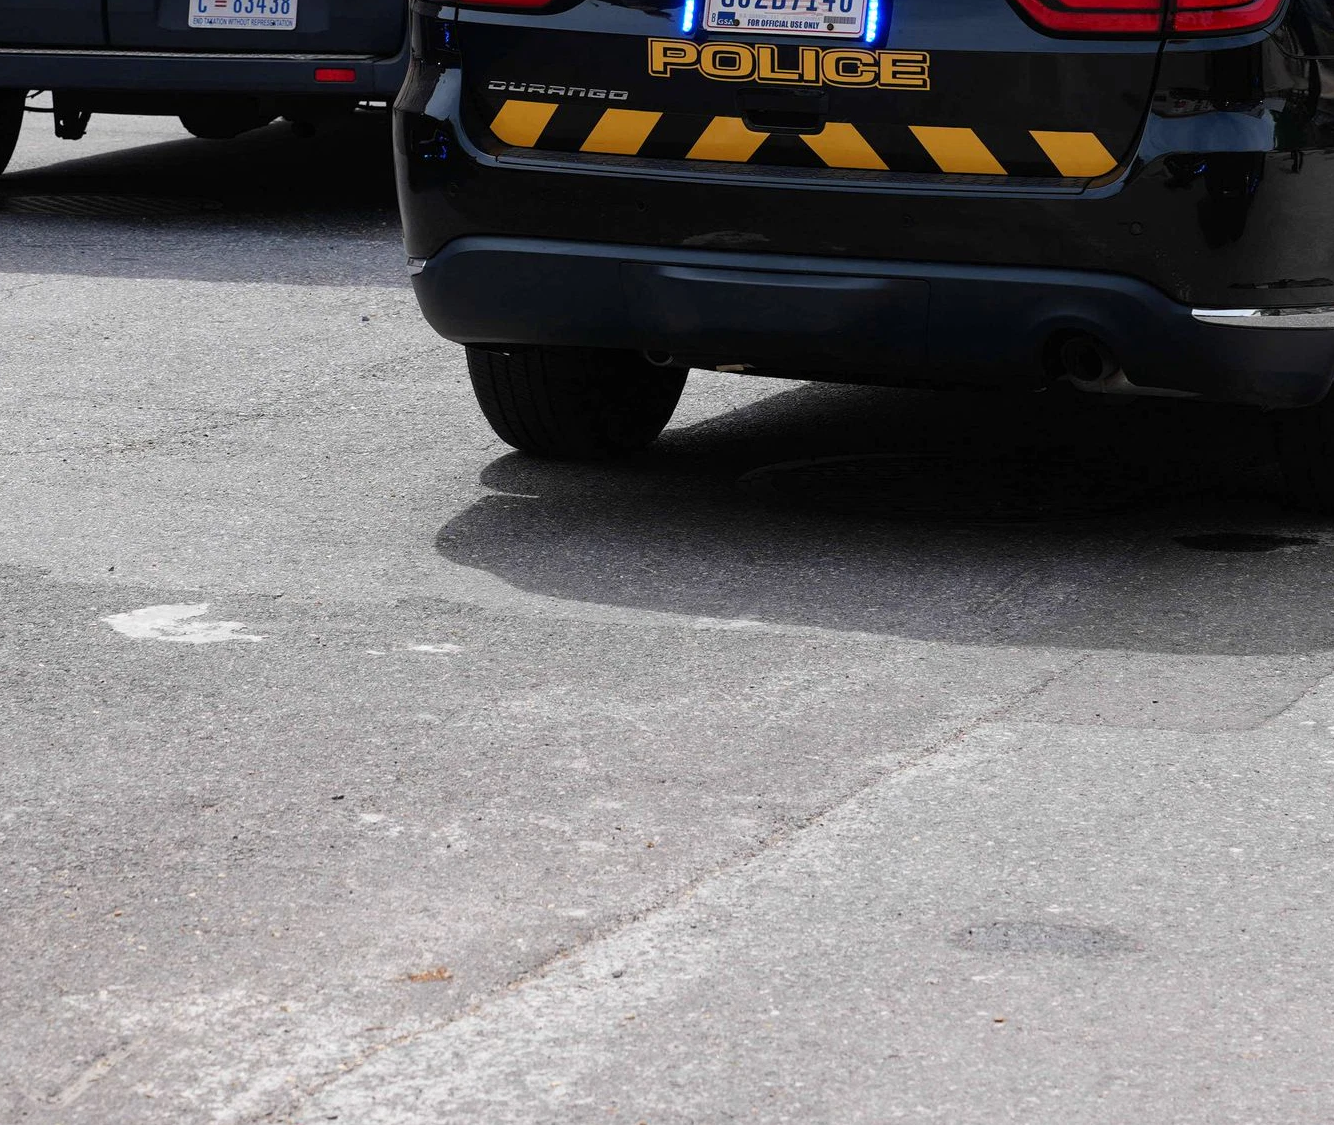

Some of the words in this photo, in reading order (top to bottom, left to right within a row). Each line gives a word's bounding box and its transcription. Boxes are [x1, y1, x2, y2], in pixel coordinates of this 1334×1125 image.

[192, 17, 203, 25] END
[228, 18, 250, 26] WITHOUT
[747, 18, 760, 26] FOR
[761, 19, 789, 28] OFFICIAL
[790, 20, 803, 28] USE
[804, 20, 820, 29] ONLY
[648, 39, 930, 91] POLICE
[488, 80, 629, 100] DURANGO
